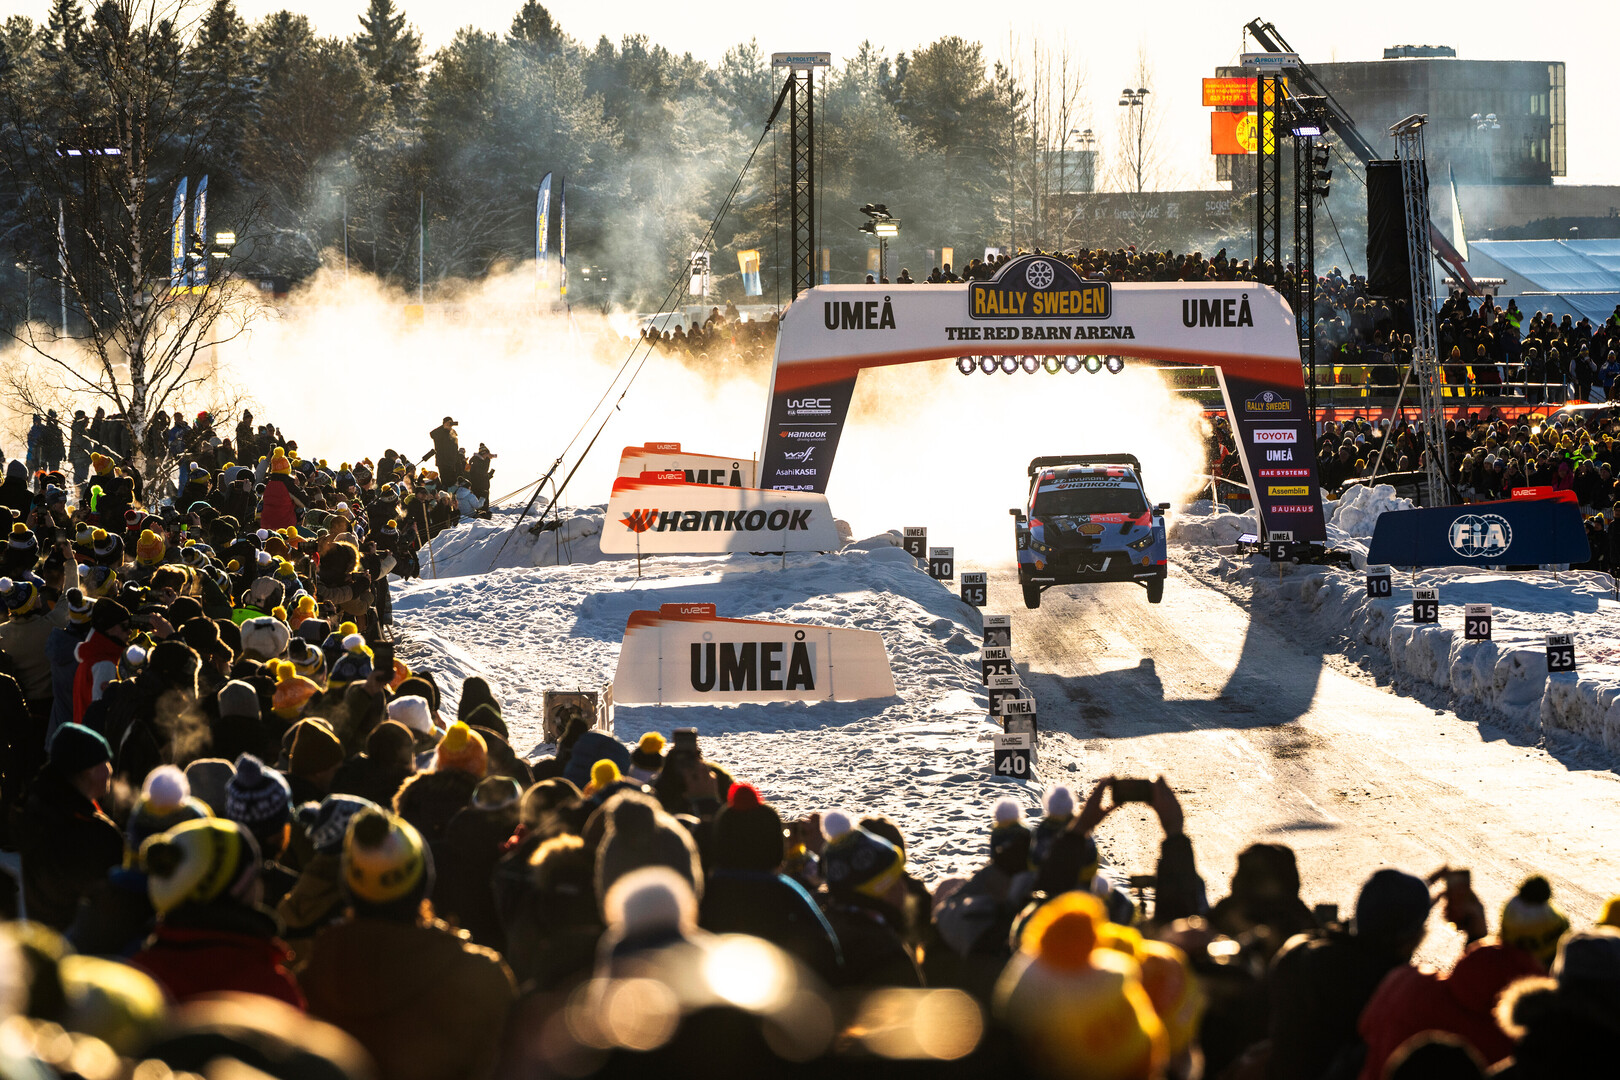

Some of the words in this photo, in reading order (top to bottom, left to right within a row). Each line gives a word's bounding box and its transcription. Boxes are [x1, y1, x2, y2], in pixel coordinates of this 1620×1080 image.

[975, 287, 1027, 314] RALLY
[1033, 287, 1105, 314] SWEDEN
[824, 295, 896, 330] UMEÅ
[1182, 293, 1254, 328] UMEÅ
[945, 327, 981, 340] THE
[983, 326, 1020, 340] RED
[1022, 326, 1072, 340] BARN
[1074, 326, 1135, 340] ARENA
[787, 398, 831, 408] WRC
[1247, 401, 1265, 411] RALLY
[1266, 401, 1290, 411] SWEDEN
[1266, 448, 1293, 461] UMEÅ
[906, 527, 924, 536] UMEÅ
[1272, 532, 1290, 541] UMEÅ
[911, 541, 919, 554] 5
[1277, 545, 1286, 558] 5
[932, 562, 951, 576] 10
[964, 573, 984, 584] UMEÅ
[1370, 579, 1389, 593] 10
[965, 588, 984, 603] 15
[1416, 590, 1436, 599] UMEÅ
[680, 606, 710, 614] WRC
[1416, 604, 1436, 619] 15
[1468, 620, 1489, 636] 20
[1548, 634, 1571, 646] UMEÅ
[985, 648, 1007, 659] UMEÅ
[1550, 651, 1572, 667] 25
[690, 629, 816, 692] UMEÅ
[1007, 701, 1032, 714] UMEÅ
[998, 755, 1026, 775] 40
